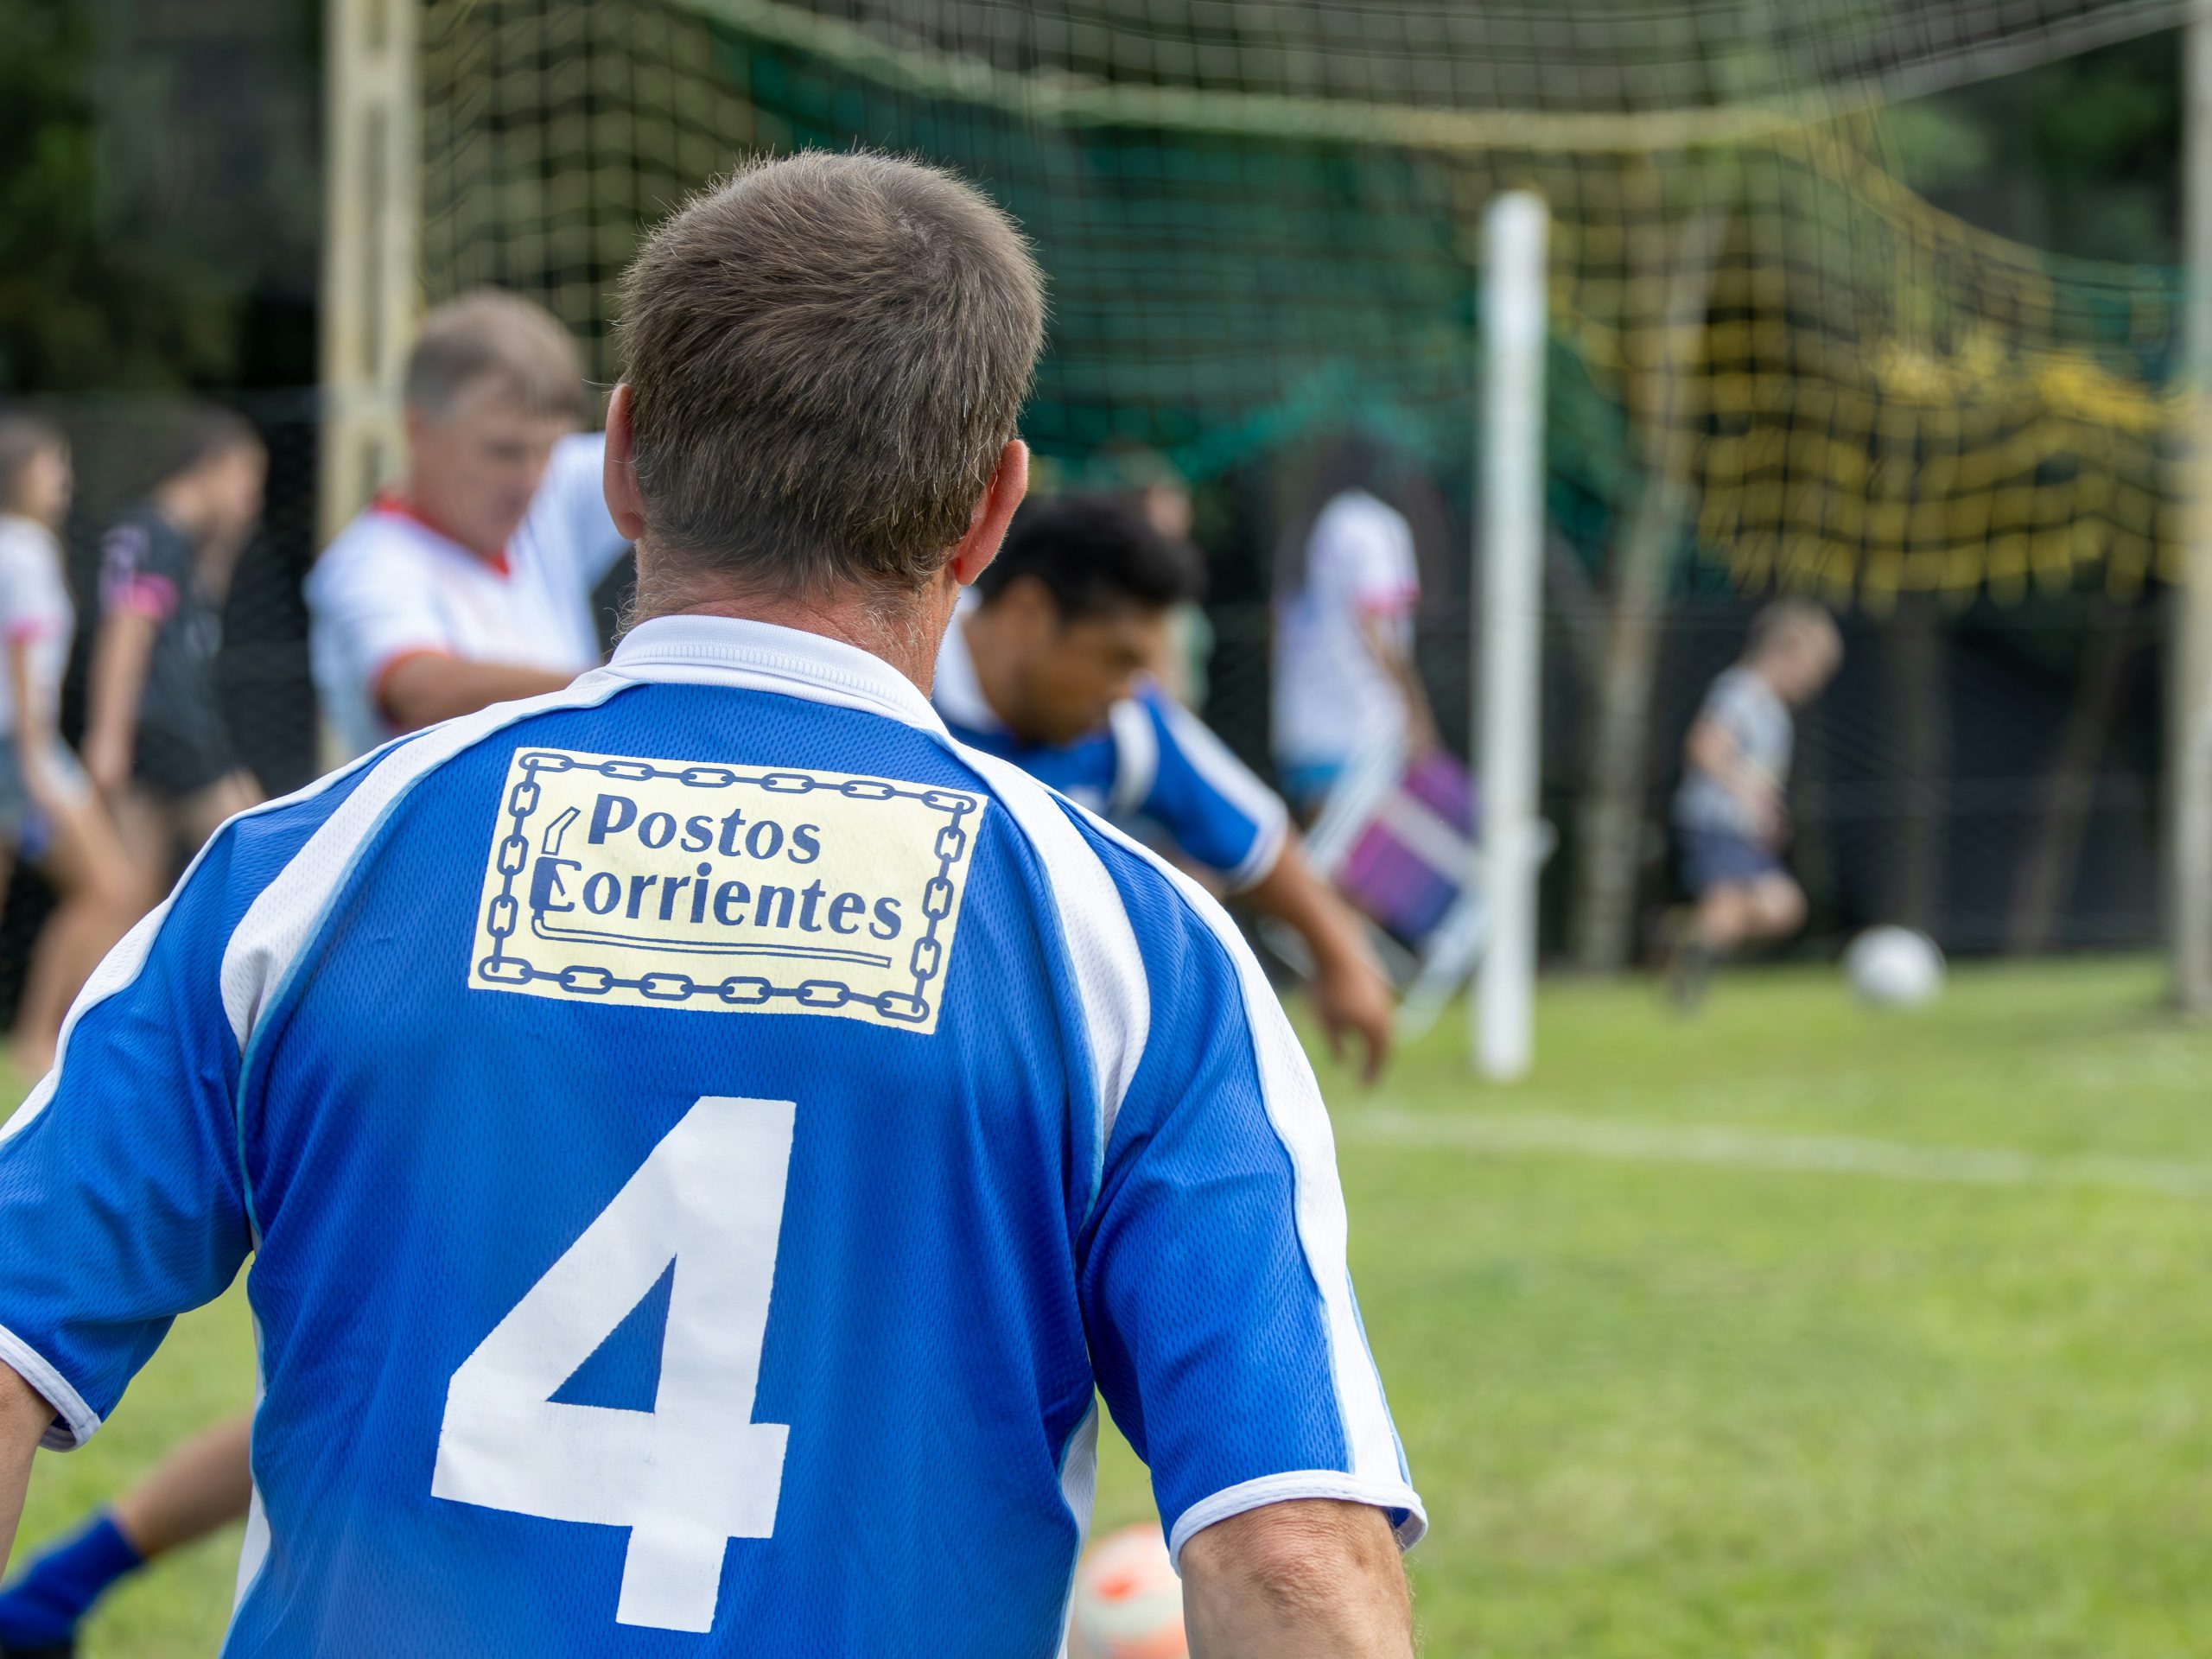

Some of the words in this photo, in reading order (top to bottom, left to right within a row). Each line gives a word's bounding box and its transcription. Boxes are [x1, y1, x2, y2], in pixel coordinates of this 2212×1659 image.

[588, 793, 821, 864] Postos
[529, 856, 903, 940] Corrientes
[430, 1095, 797, 1634] 4
